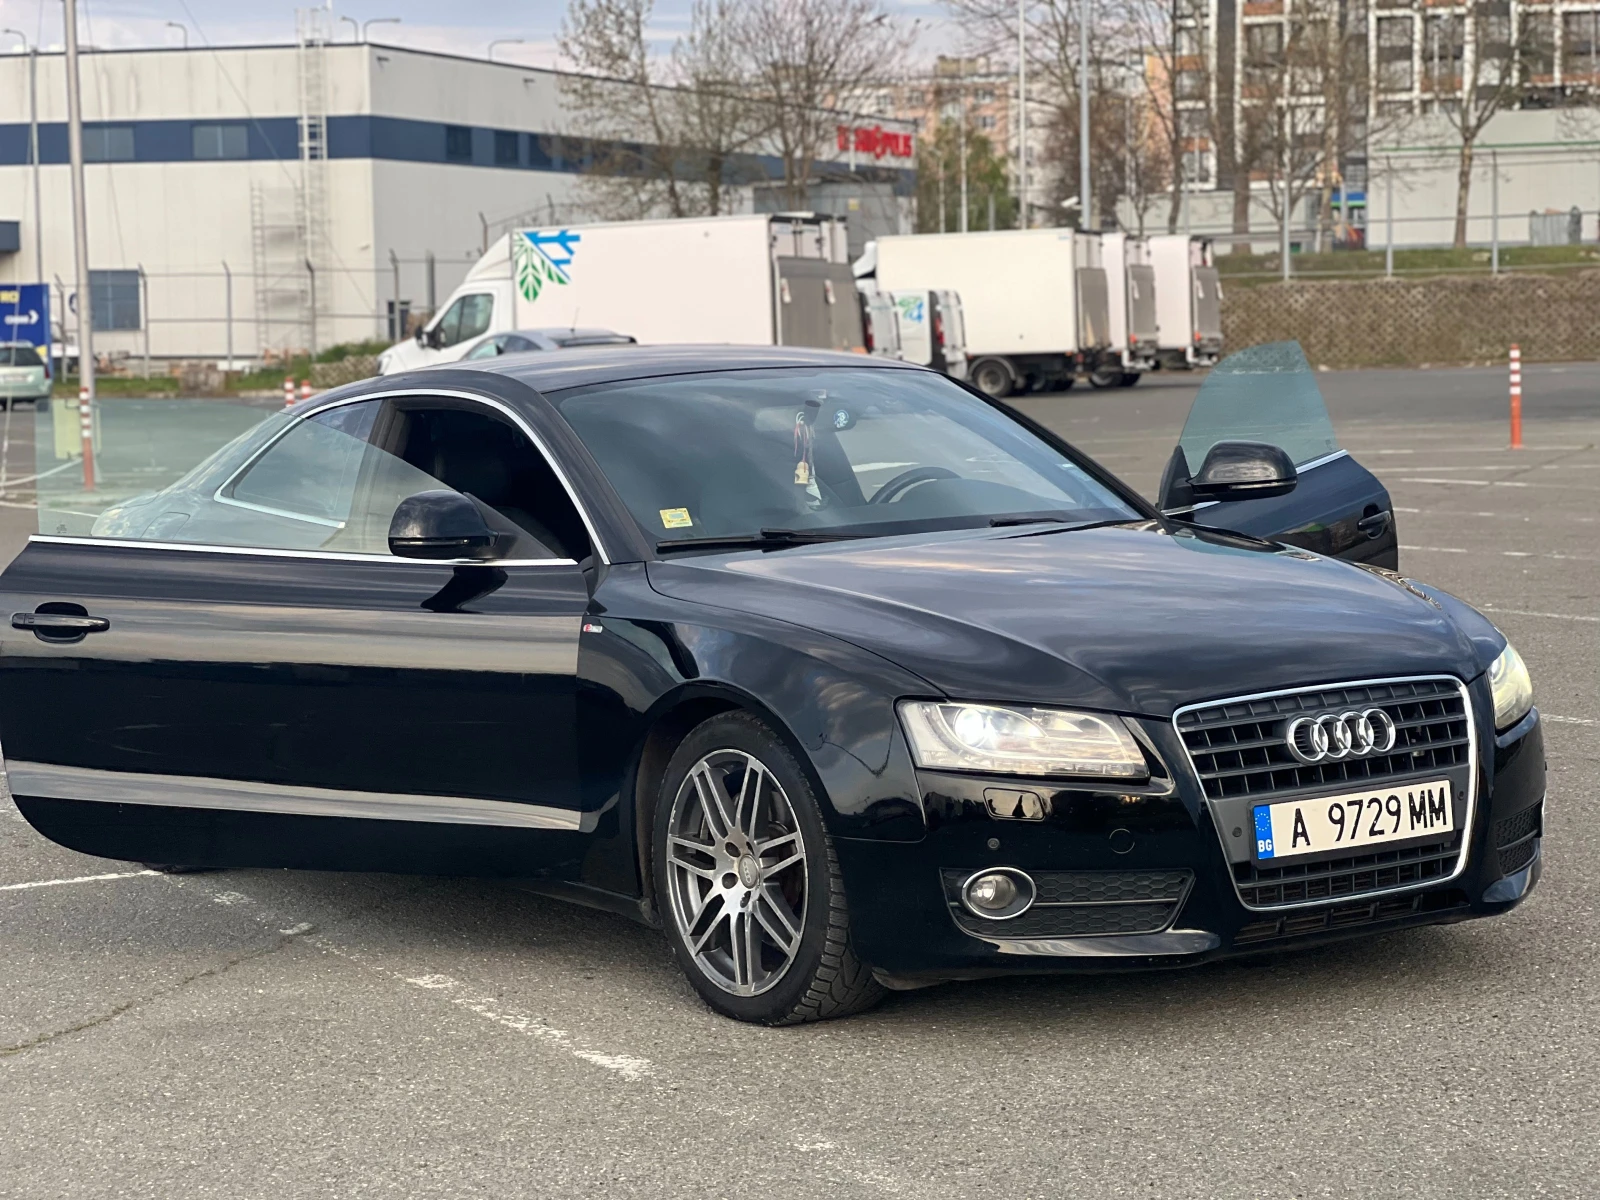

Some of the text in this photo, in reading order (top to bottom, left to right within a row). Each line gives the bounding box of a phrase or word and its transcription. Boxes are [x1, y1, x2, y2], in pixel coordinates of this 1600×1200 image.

[1292, 787, 1447, 848] A 9729 MM
[1258, 840, 1273, 852] BG
